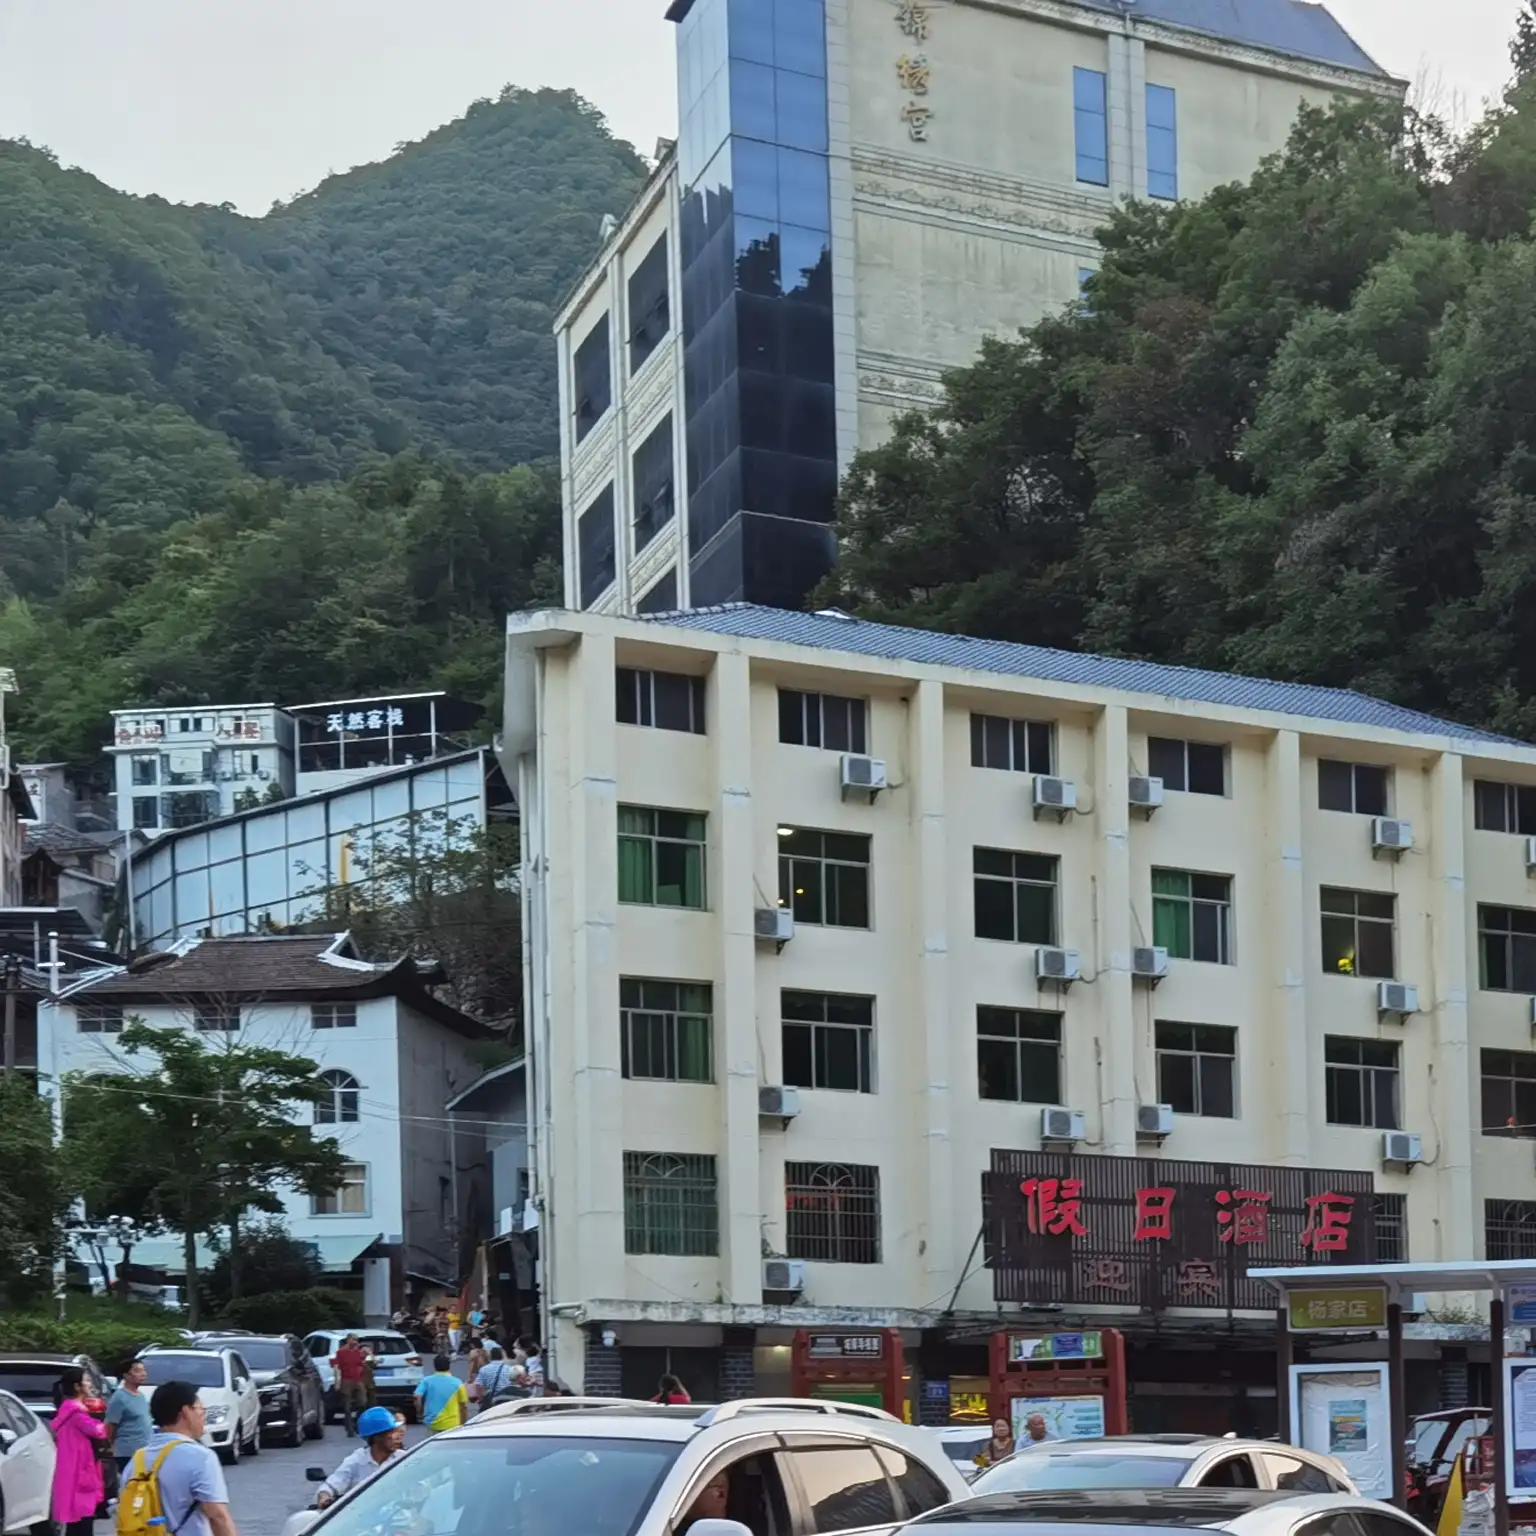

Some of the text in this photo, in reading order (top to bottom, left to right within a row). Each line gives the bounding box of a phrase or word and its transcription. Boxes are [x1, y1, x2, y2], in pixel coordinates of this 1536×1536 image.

[327, 708, 404, 732] 天然客栈
[1020, 1178, 1355, 1252] 假日酒店
[1308, 1300, 1368, 1319] 杨家店
